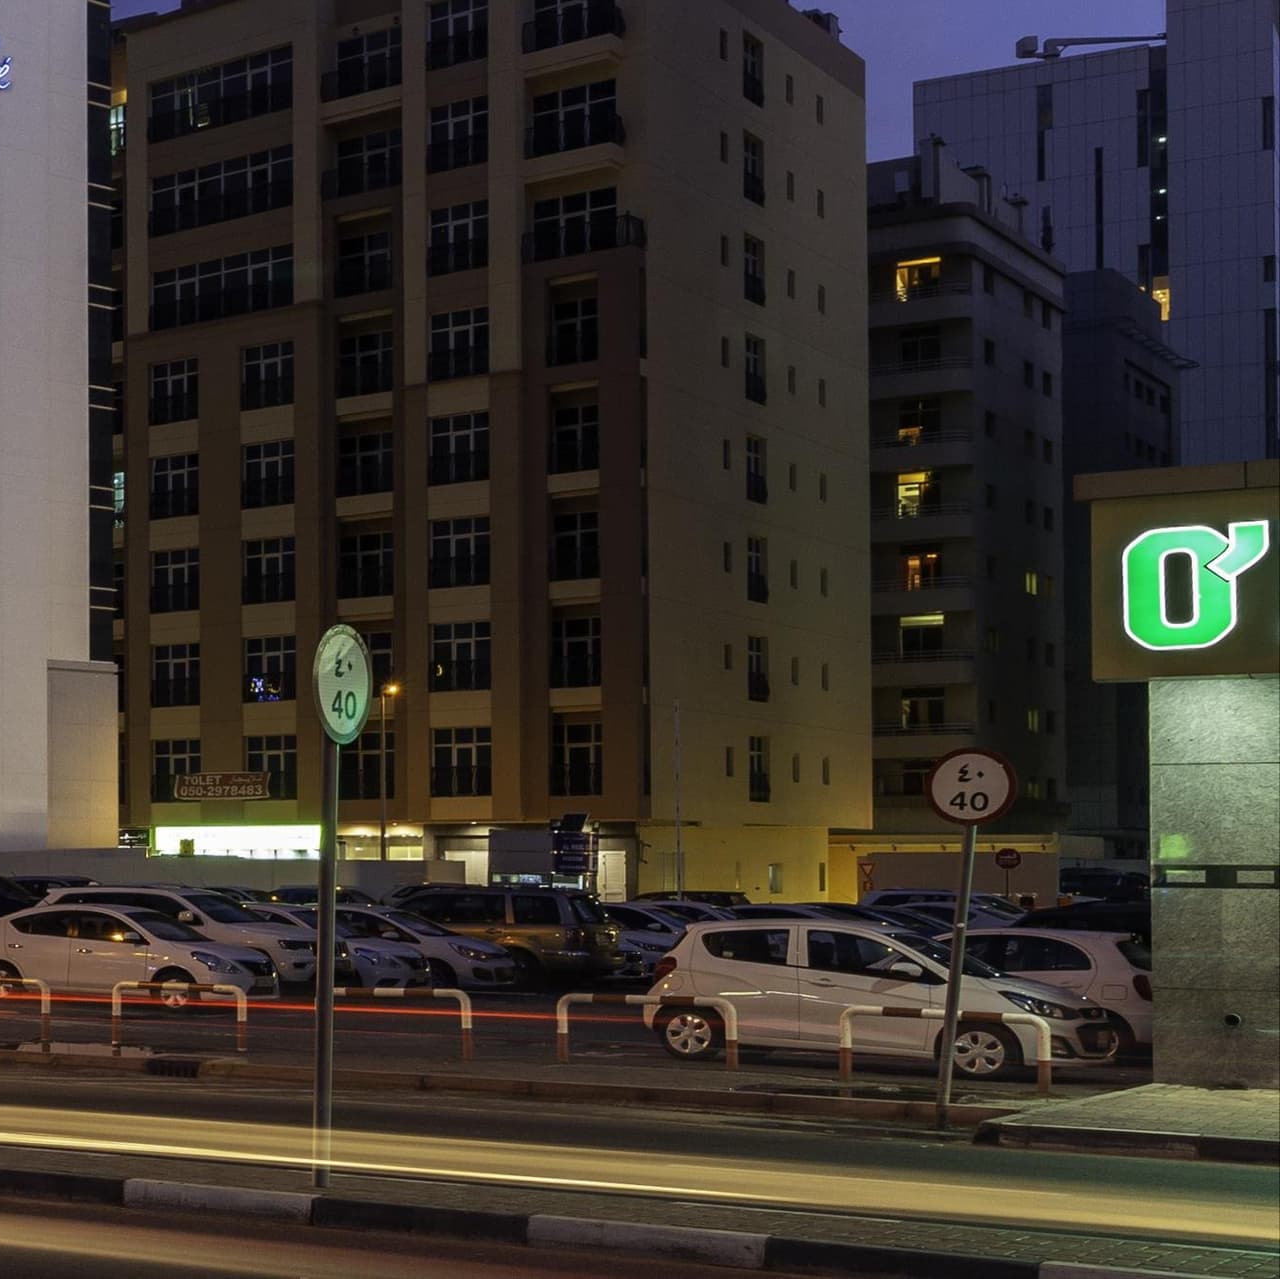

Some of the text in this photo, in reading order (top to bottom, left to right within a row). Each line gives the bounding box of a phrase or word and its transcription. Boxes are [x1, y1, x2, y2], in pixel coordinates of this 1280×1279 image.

[331, 690, 357, 720] 40
[958, 763, 985, 783] ٤٠
[949, 791, 989, 812] 40
